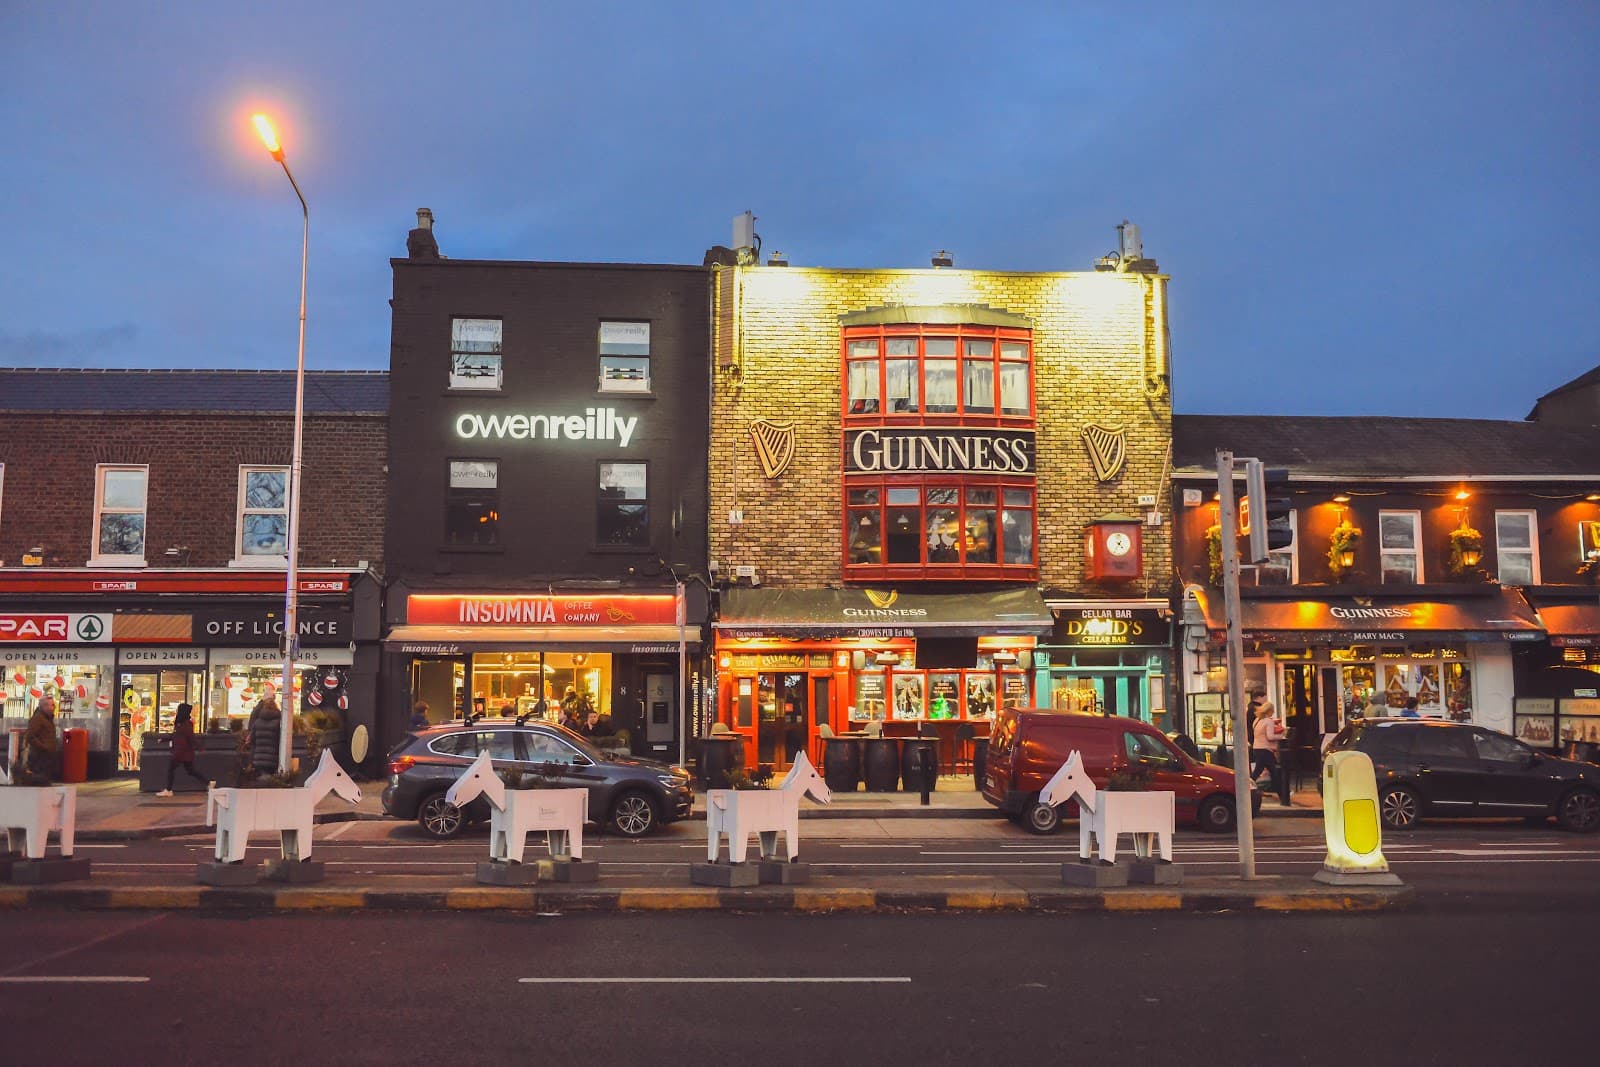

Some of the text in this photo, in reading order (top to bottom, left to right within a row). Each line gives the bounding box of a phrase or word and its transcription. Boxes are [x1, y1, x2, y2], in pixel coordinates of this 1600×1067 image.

[456, 408, 638, 447] owenreilly
[853, 430, 1029, 472] GUINNESS
[564, 602, 592, 611] COFFEE
[459, 600, 556, 623] INSOMNIA
[843, 608, 927, 617] GUINNESS
[1081, 610, 1132, 618] CELLAR BAR
[1330, 606, 1412, 618] GUINNESS
[564, 613, 600, 623] COMPANY
[206, 621, 337, 635] OFF LICNCE
[1354, 632, 1377, 640] MARY
[401, 643, 459, 653] insomnia.ie
[162, 652, 199, 660] 24HRS
[245, 652, 276, 660] OPEN
[620, 686, 626, 695] 8
